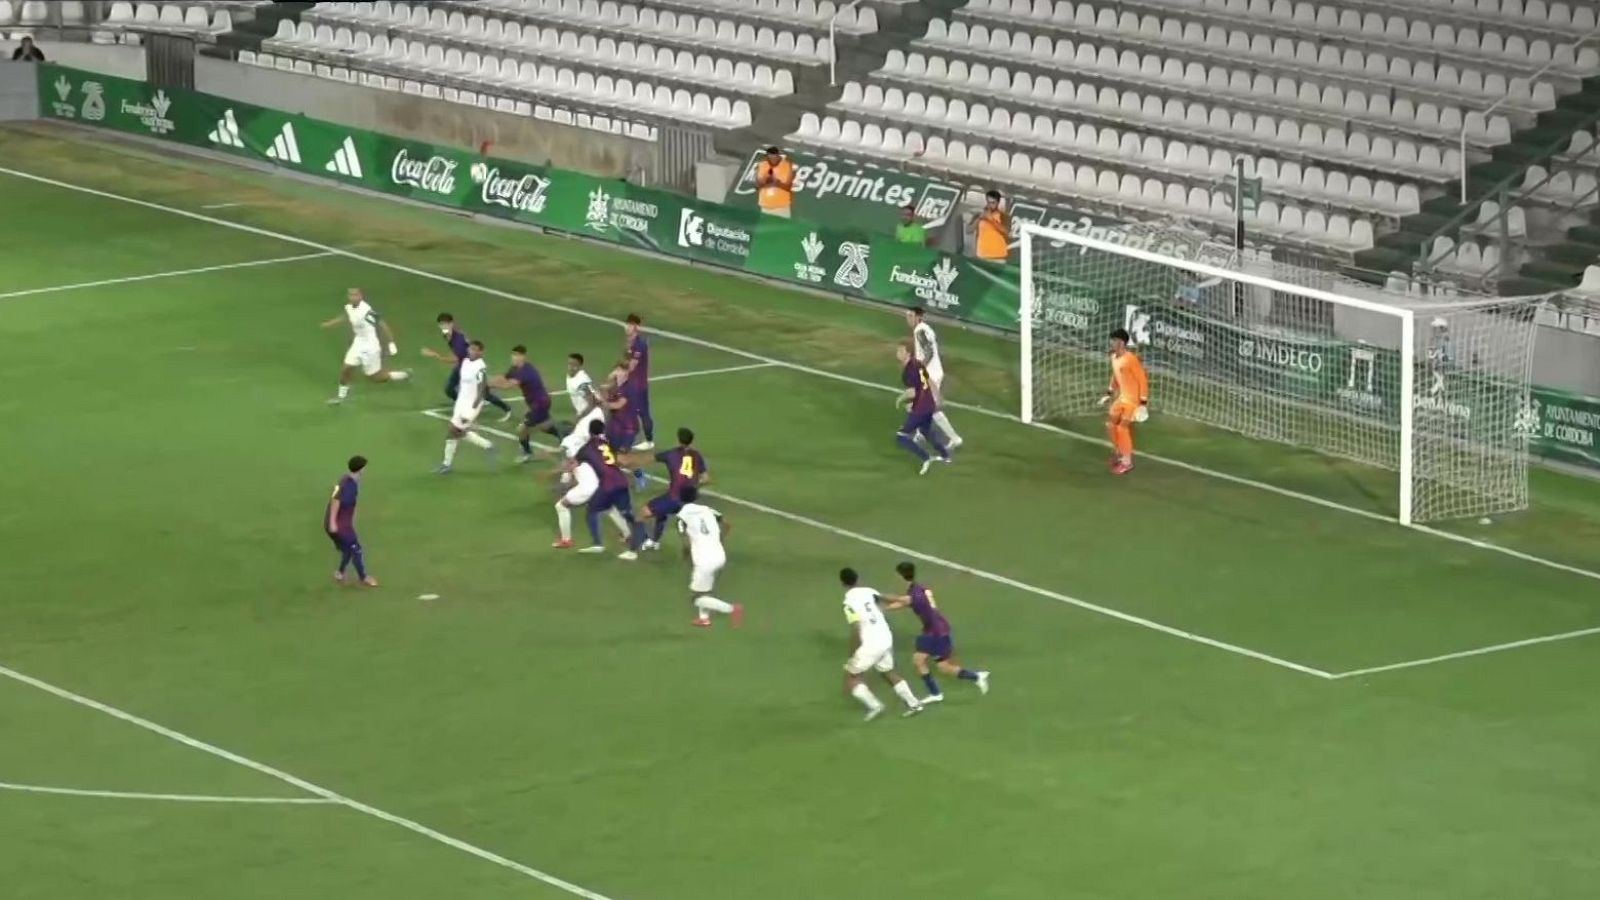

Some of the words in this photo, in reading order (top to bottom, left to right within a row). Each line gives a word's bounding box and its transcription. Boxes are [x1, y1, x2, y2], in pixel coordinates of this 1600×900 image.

[791, 162, 915, 207] g3print.es
[1256, 341, 1322, 373] IMDECO
[598, 443, 616, 465] 3
[679, 456, 694, 479] 4
